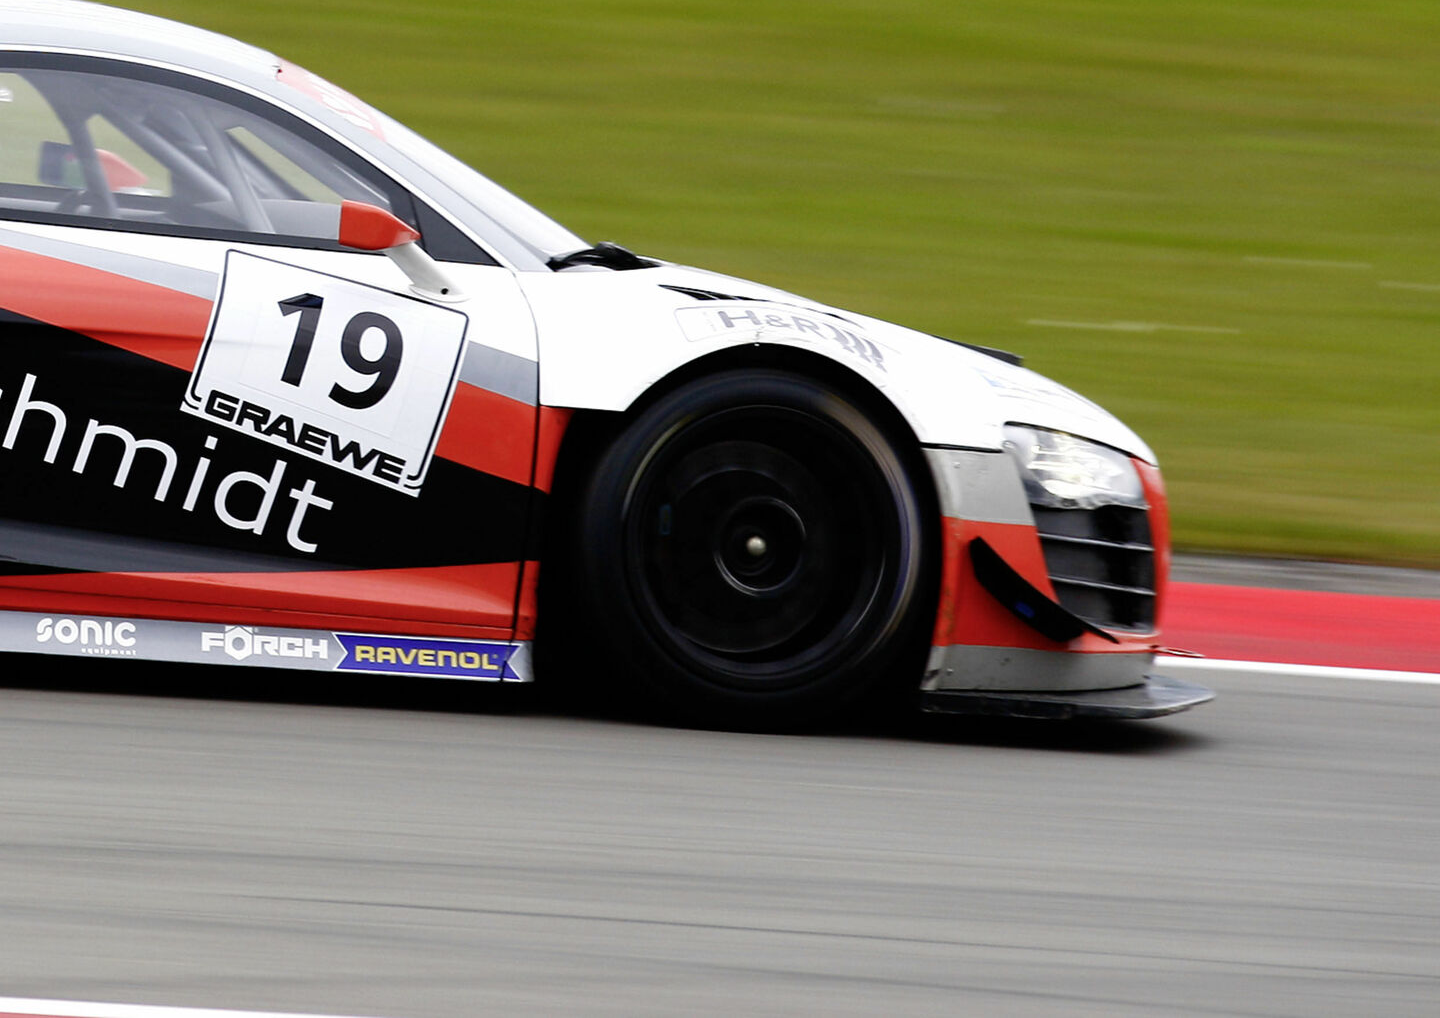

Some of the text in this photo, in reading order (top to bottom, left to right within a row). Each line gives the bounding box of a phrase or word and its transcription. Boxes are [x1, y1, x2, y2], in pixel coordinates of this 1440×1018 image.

[277, 292, 403, 411] 19
[205, 389, 407, 485] GRAEWE
[81, 647, 137, 656] equipment
[355, 645, 499, 671] RAVENOL
